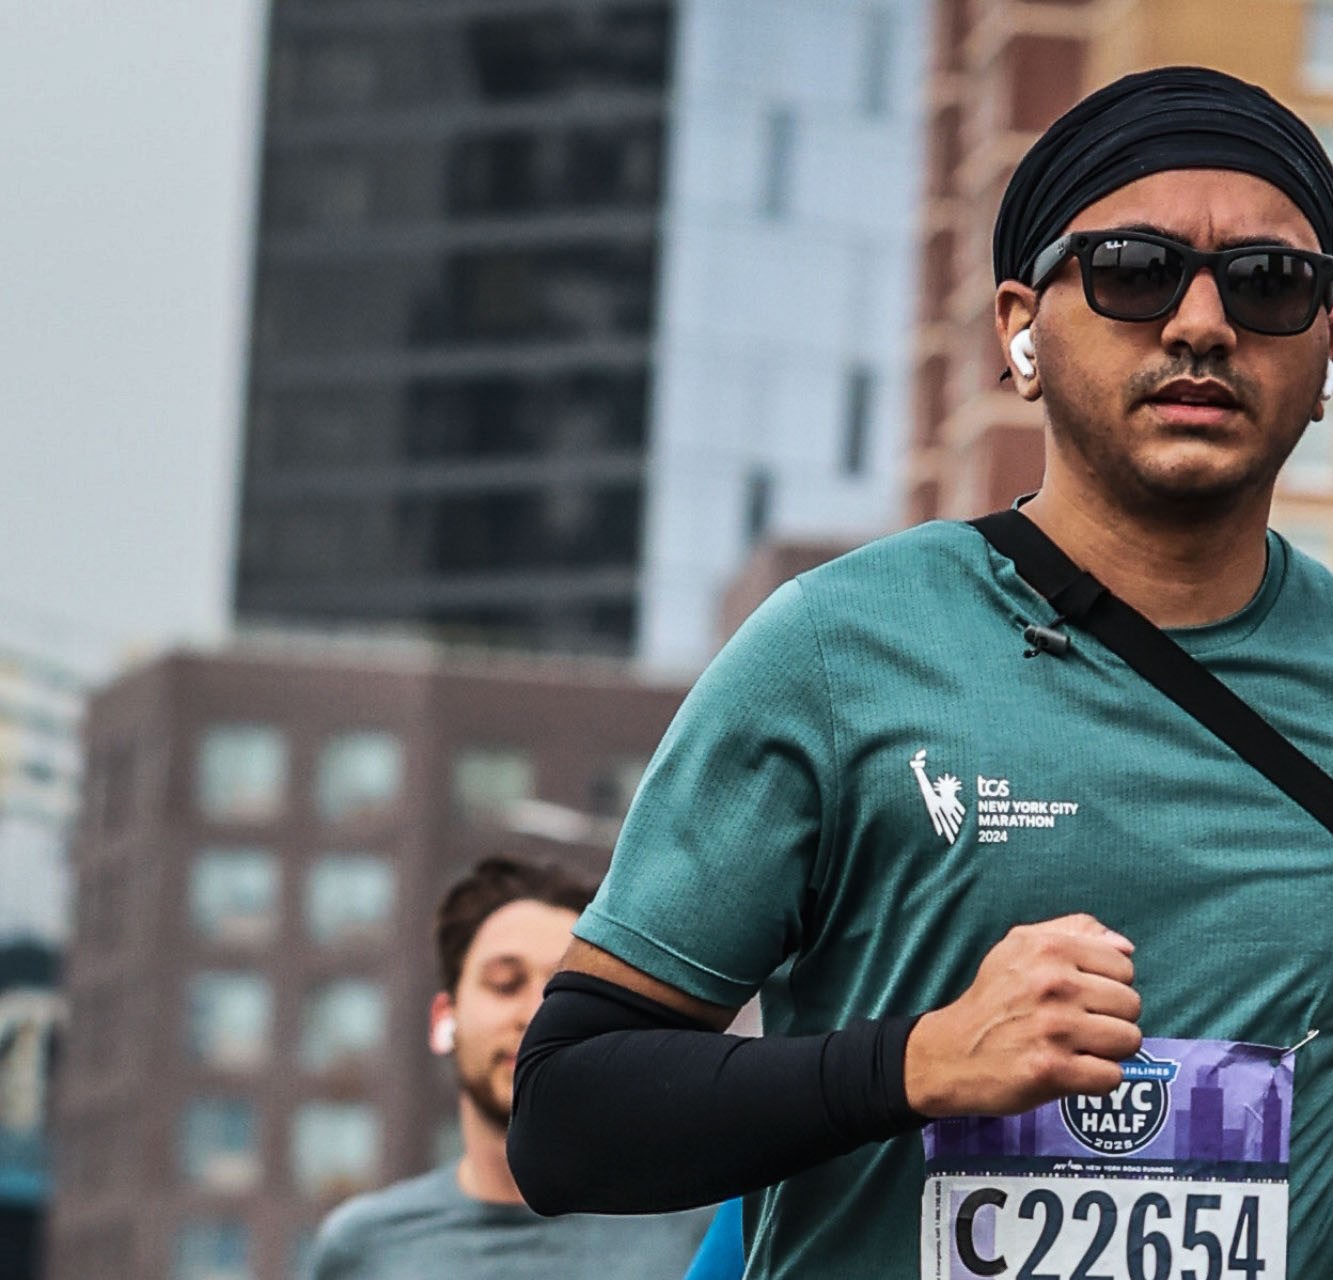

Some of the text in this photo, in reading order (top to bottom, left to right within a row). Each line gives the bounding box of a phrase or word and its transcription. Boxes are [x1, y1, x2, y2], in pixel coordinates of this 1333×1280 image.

[977, 775, 1009, 797] tcs
[978, 801, 1079, 815] NEW YORK CITY
[978, 815, 1055, 828] MARATHON
[978, 830, 1008, 842] 2024
[1122, 1067, 1170, 1076] IRLINES
[1082, 1113, 1147, 1133] HALF
[1094, 1138, 1133, 1150] 2025
